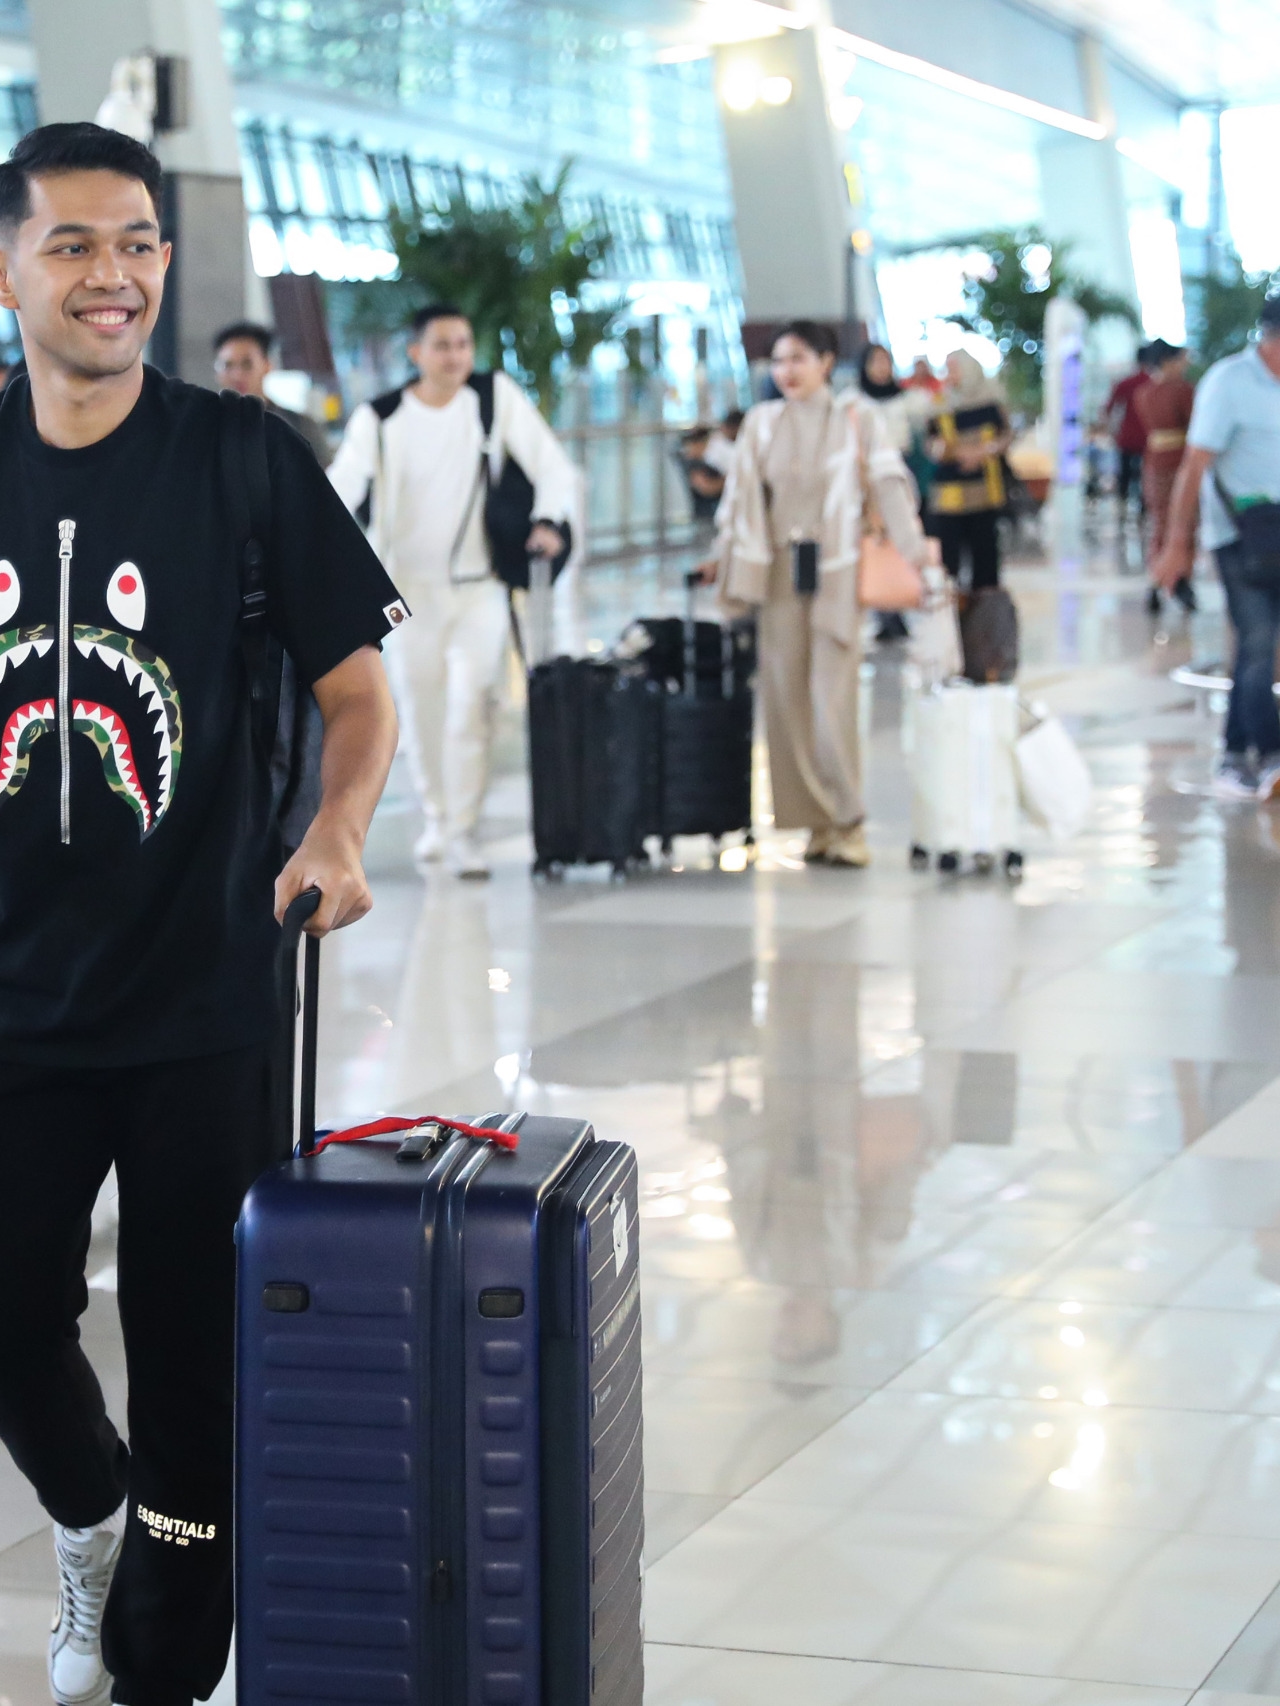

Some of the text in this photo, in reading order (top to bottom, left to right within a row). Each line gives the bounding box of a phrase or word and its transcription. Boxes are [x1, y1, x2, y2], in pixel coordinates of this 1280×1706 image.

[137, 1503, 216, 1540] ESSENTIALS
[148, 1527, 190, 1547] FEAR OF GOD
